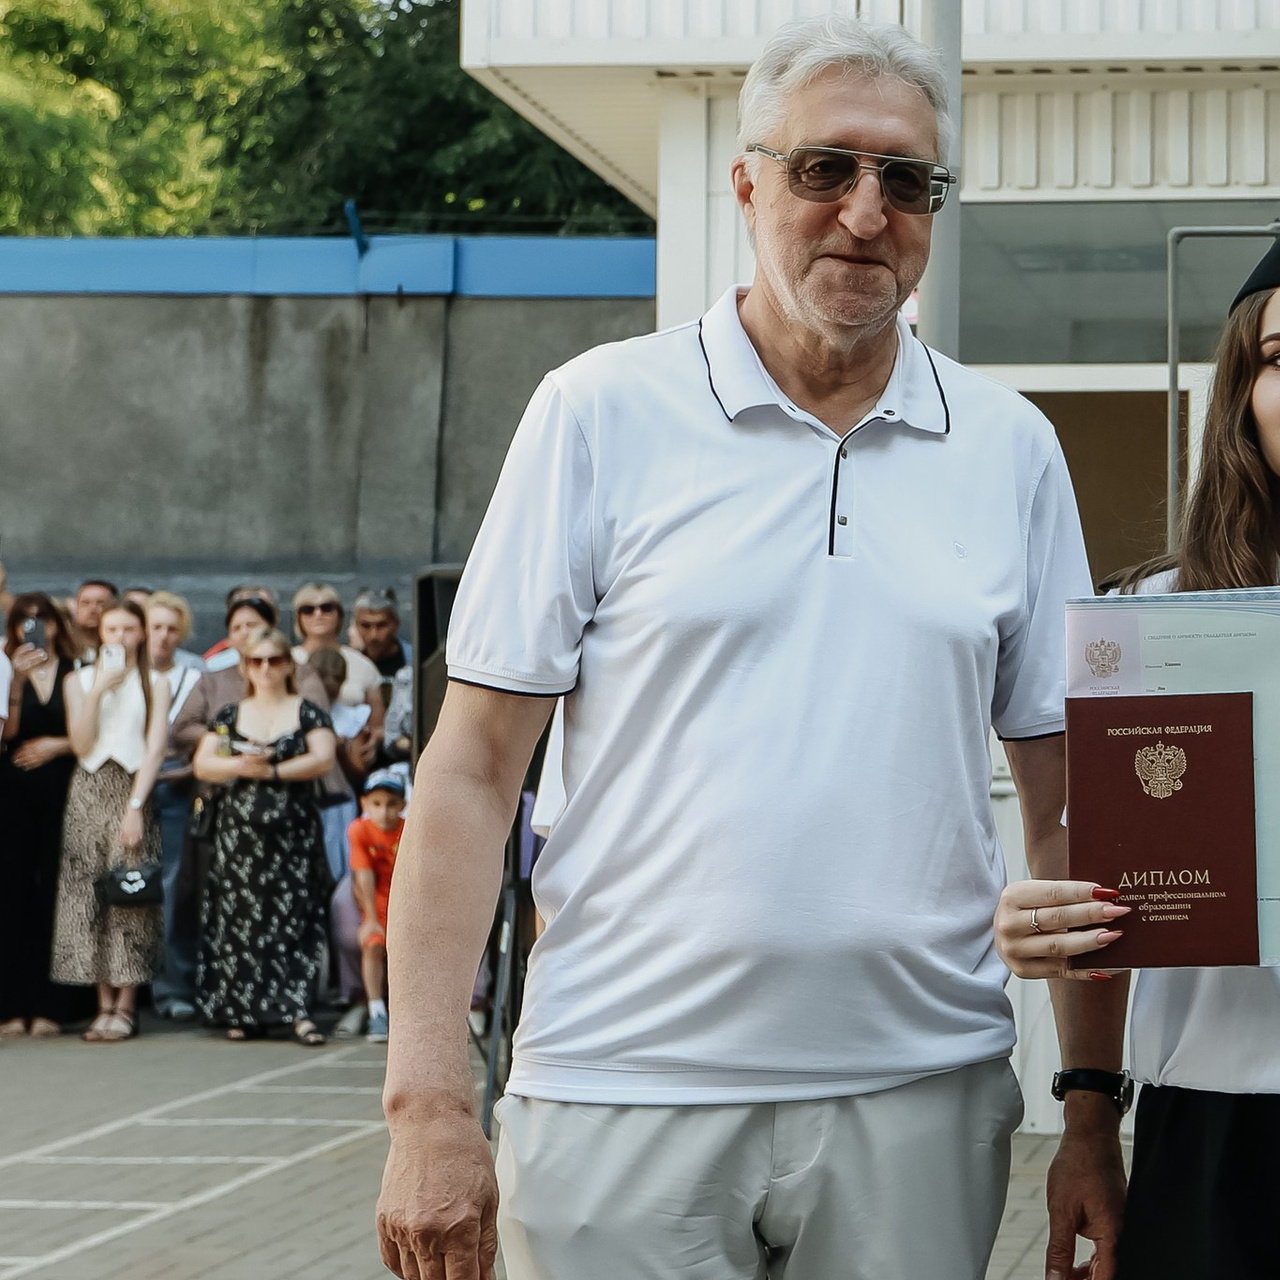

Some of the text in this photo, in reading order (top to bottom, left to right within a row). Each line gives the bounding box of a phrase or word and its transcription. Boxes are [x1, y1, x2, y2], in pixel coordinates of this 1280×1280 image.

[1107, 724, 1213, 736] РОССИЙСКАЯ ФЕДЕРАЦИЯ
[1118, 869, 1211, 889] ДИПЛОМ
[1147, 890, 1226, 902] профессиональном
[1138, 902, 1192, 913] образовании
[1148, 914, 1190, 922] отличием
